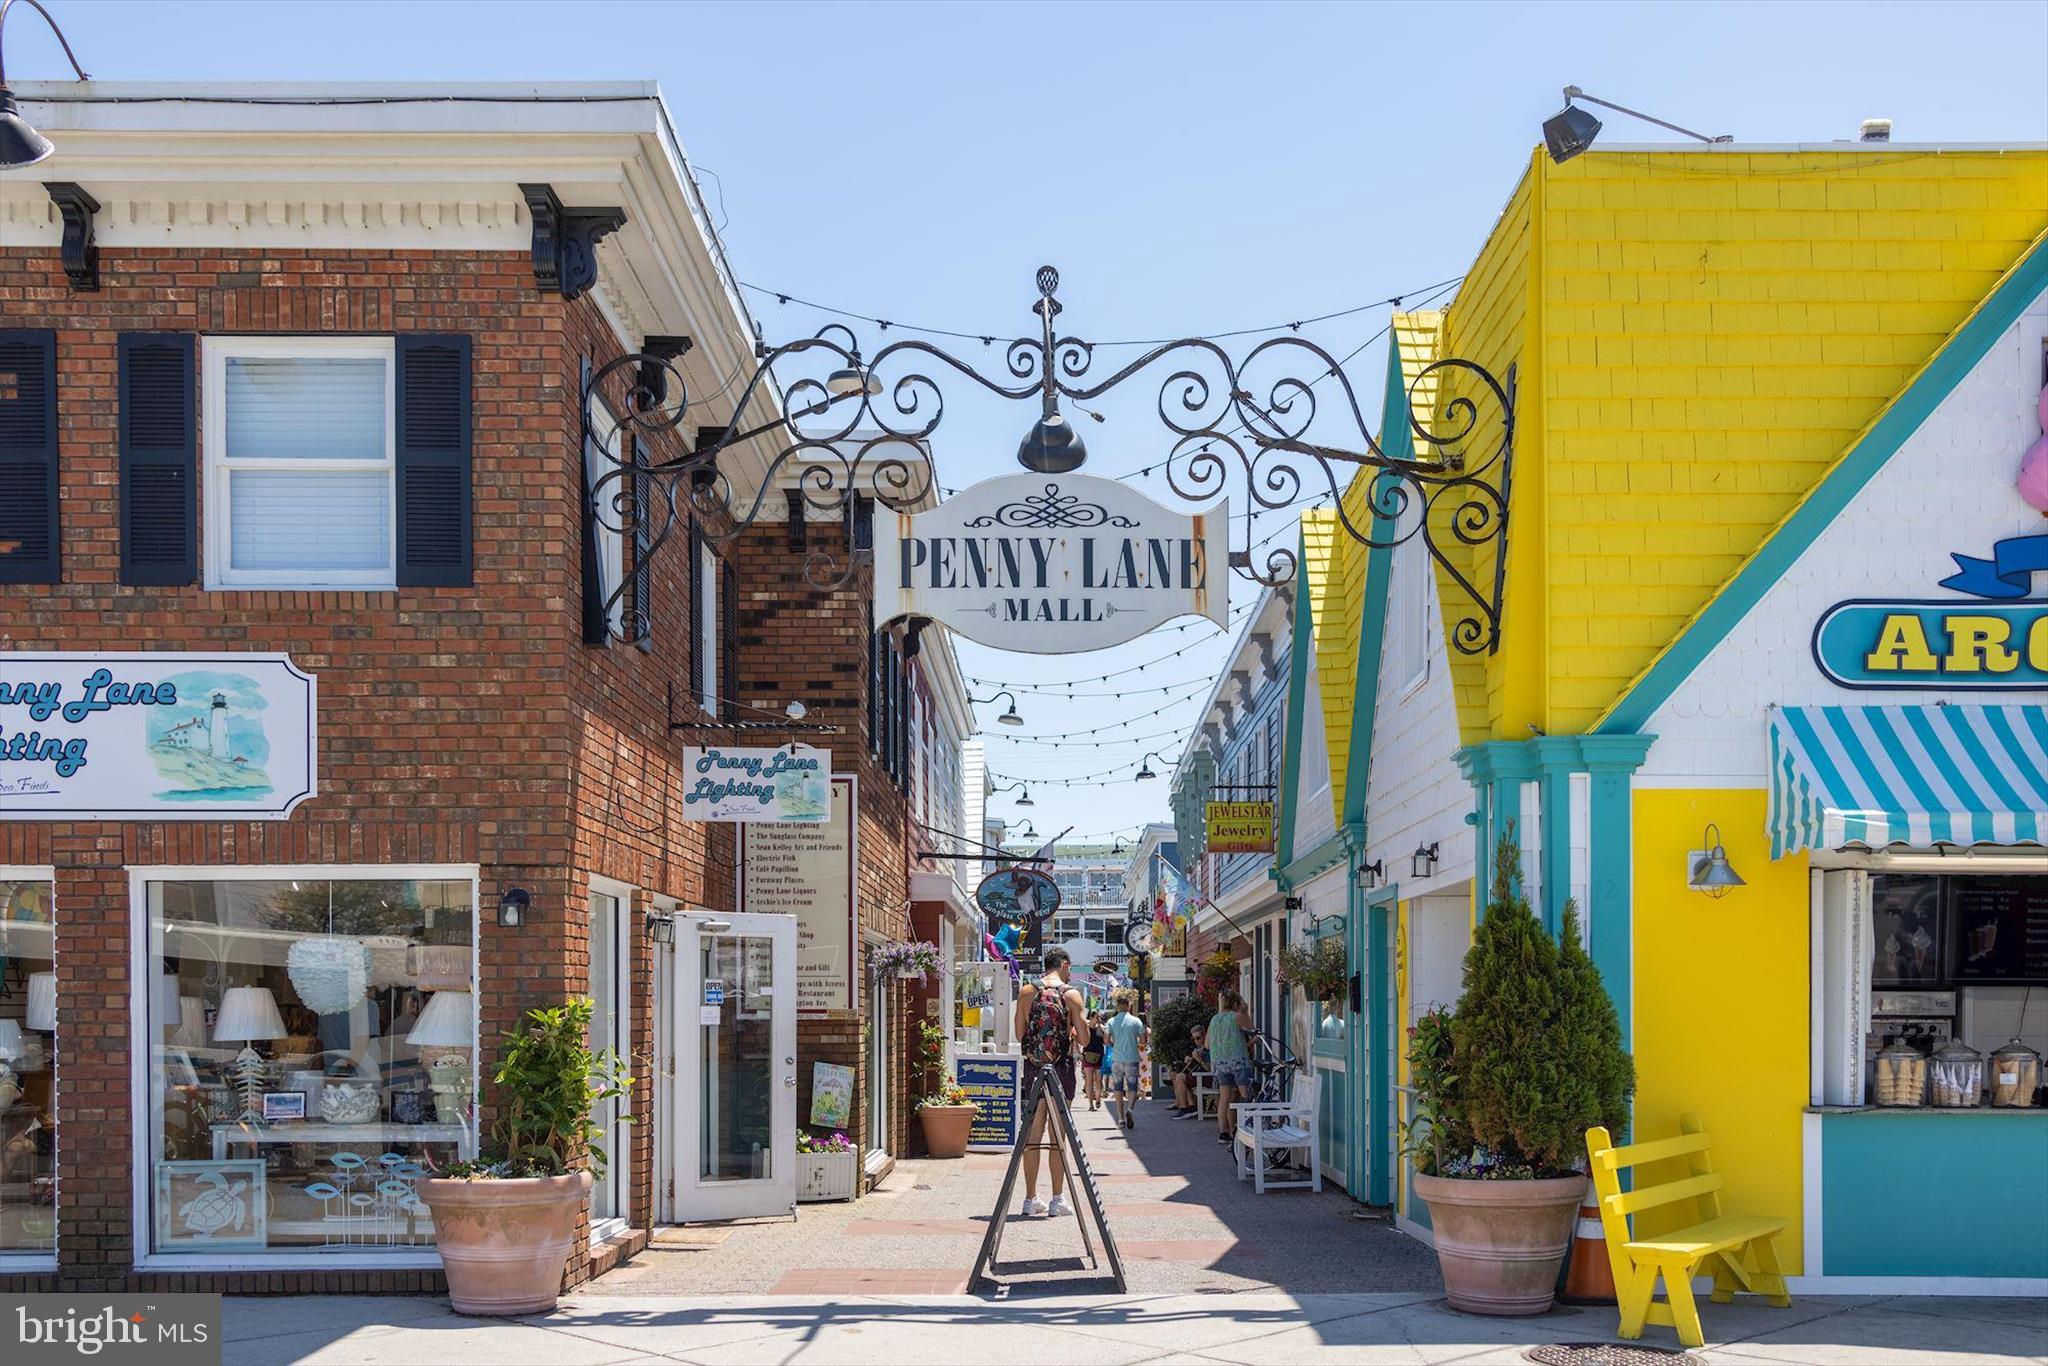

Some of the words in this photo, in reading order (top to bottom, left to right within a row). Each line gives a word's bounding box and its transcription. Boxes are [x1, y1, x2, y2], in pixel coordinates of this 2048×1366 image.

[898, 538, 1056, 589] PENNY
[1080, 537, 1206, 589] LANE
[1003, 598, 1103, 622] MALL
[62, 668, 177, 723] Lane
[696, 750, 762, 777] Penny
[762, 751, 818, 778] Lane
[685, 777, 775, 804] Lighting
[1209, 804, 1272, 822] JEWELSTAR
[793, 822, 820, 830] Lighting
[1213, 825, 1266, 839] Jewelry
[798, 833, 824, 841] Company
[984, 903, 1013, 920] Sunglass
[967, 994, 989, 1007] OPEN
